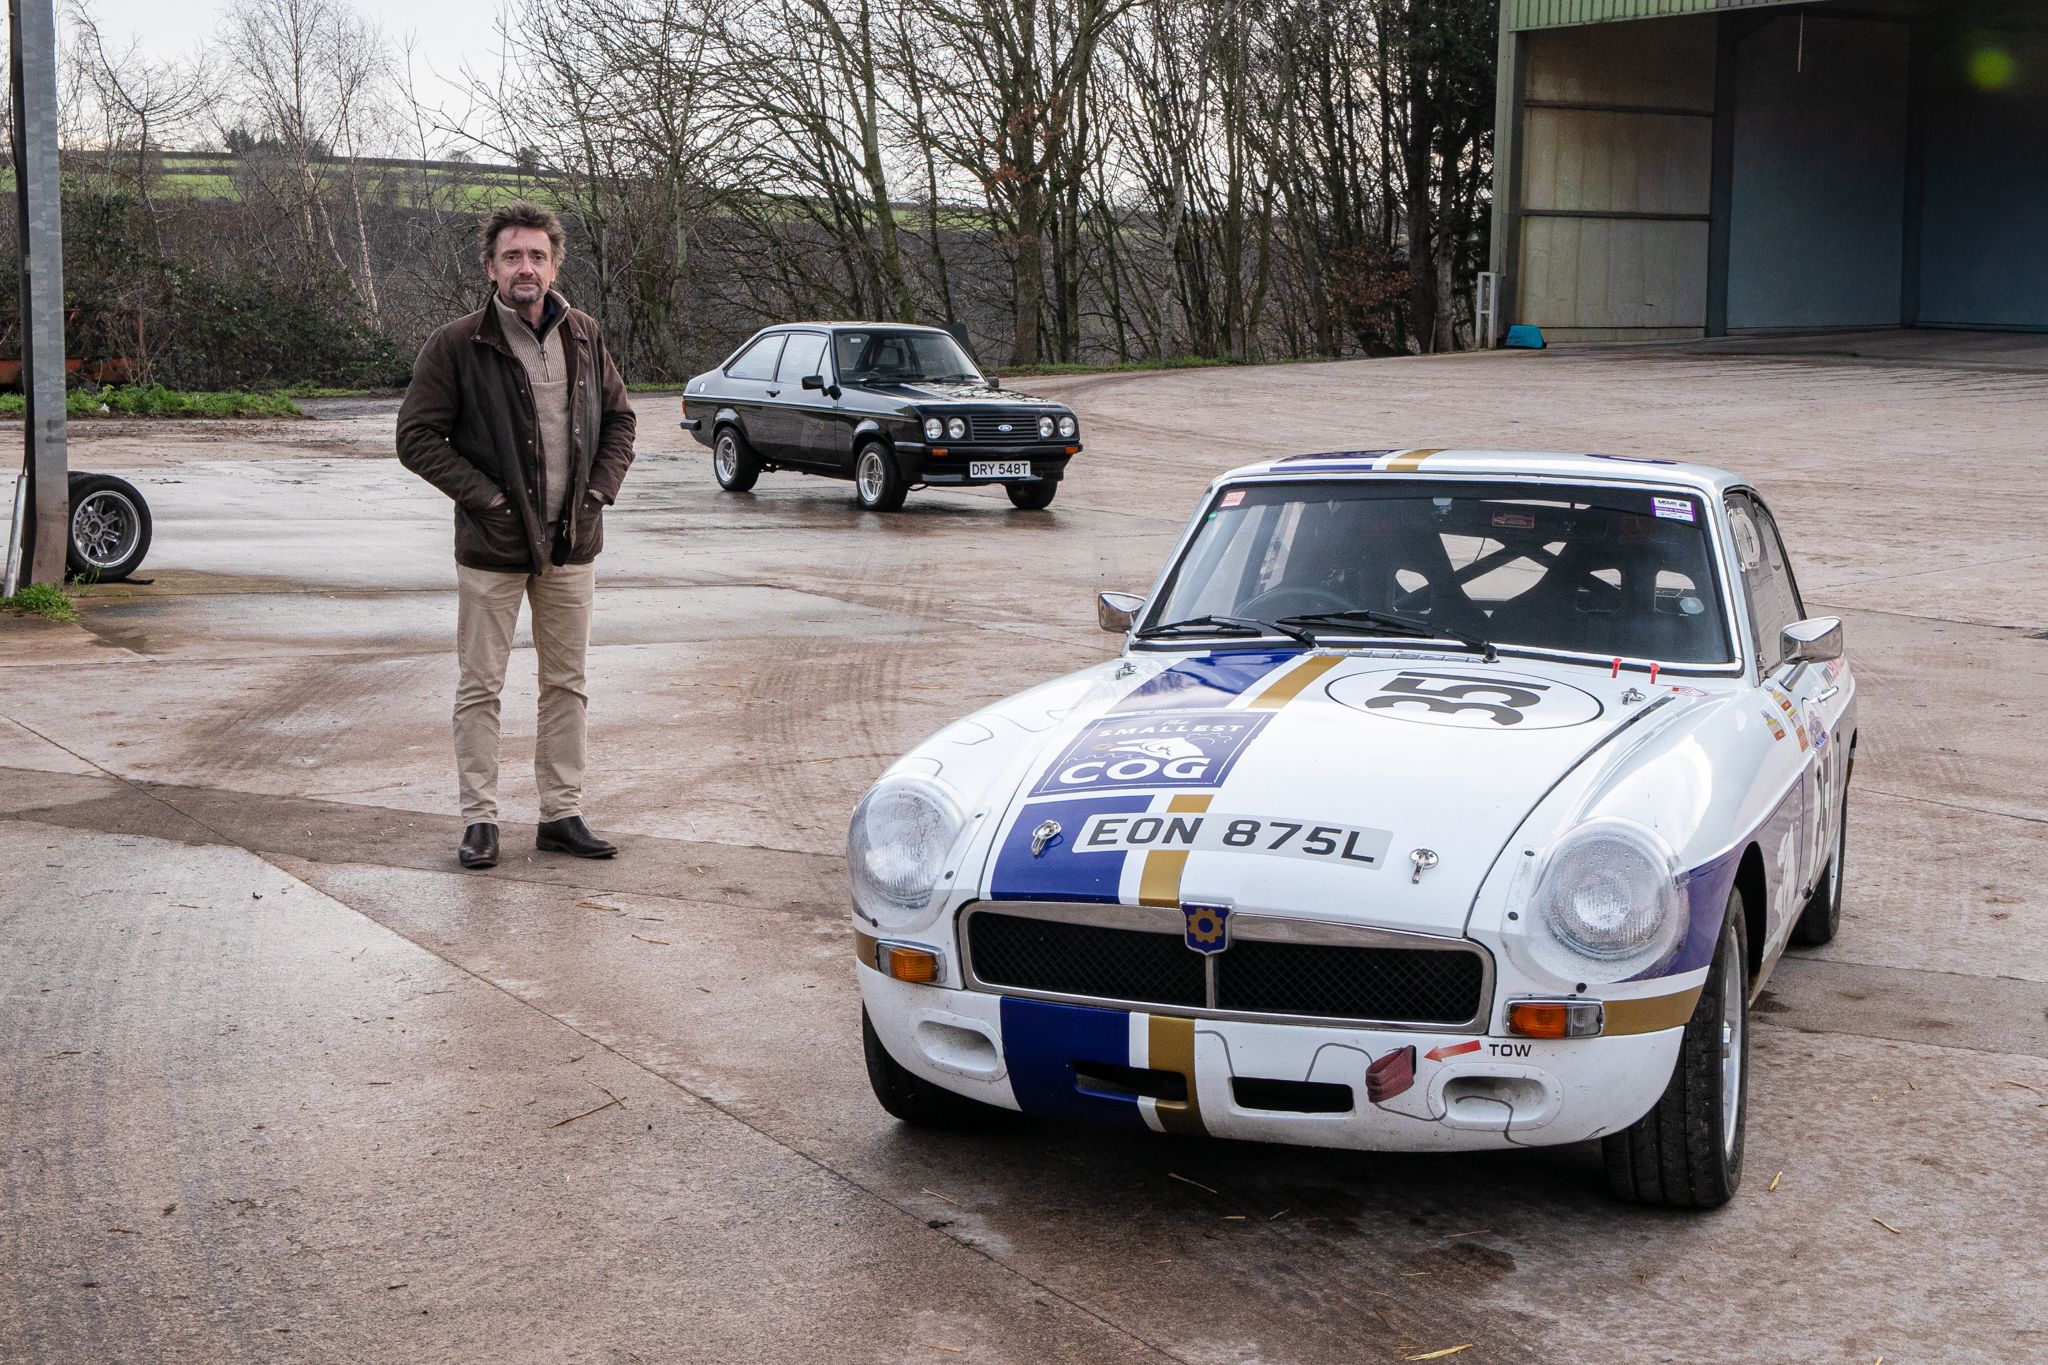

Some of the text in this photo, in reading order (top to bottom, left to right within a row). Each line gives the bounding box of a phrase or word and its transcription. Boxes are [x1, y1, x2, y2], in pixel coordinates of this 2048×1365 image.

[972, 463, 1029, 476] DRY 548T
[1098, 725, 1245, 737] SMALLEST
[1058, 757, 1212, 785] COG
[1086, 816, 1378, 864] EON 875L
[1488, 1043, 1533, 1058] TOW
